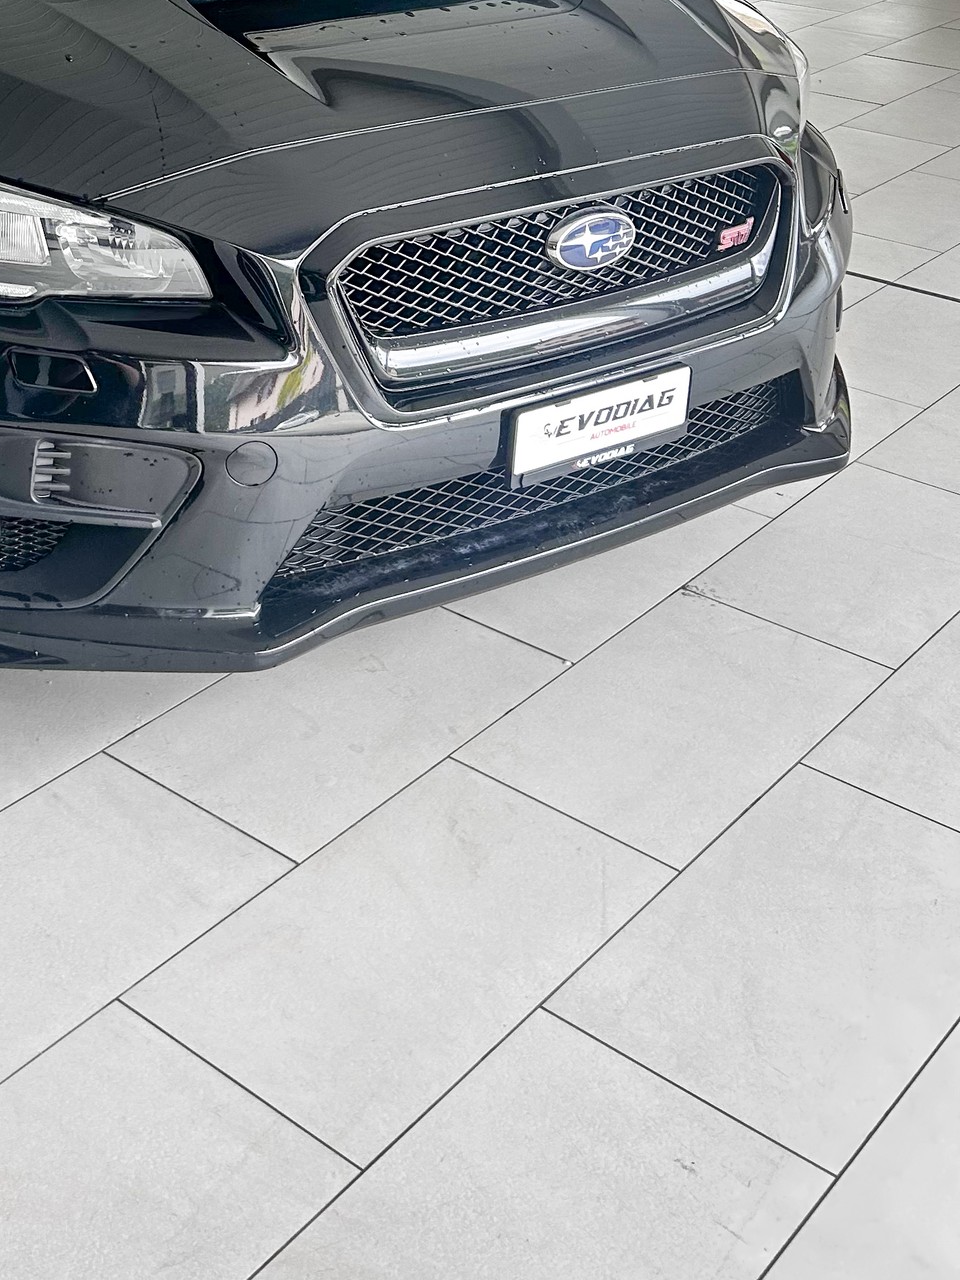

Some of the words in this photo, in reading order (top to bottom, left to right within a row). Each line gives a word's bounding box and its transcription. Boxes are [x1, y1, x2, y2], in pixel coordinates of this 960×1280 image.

[555, 388, 677, 438] EVODIAG
[590, 421, 638, 440] AUTOMOBILE
[581, 443, 635, 467] EVODIAG
